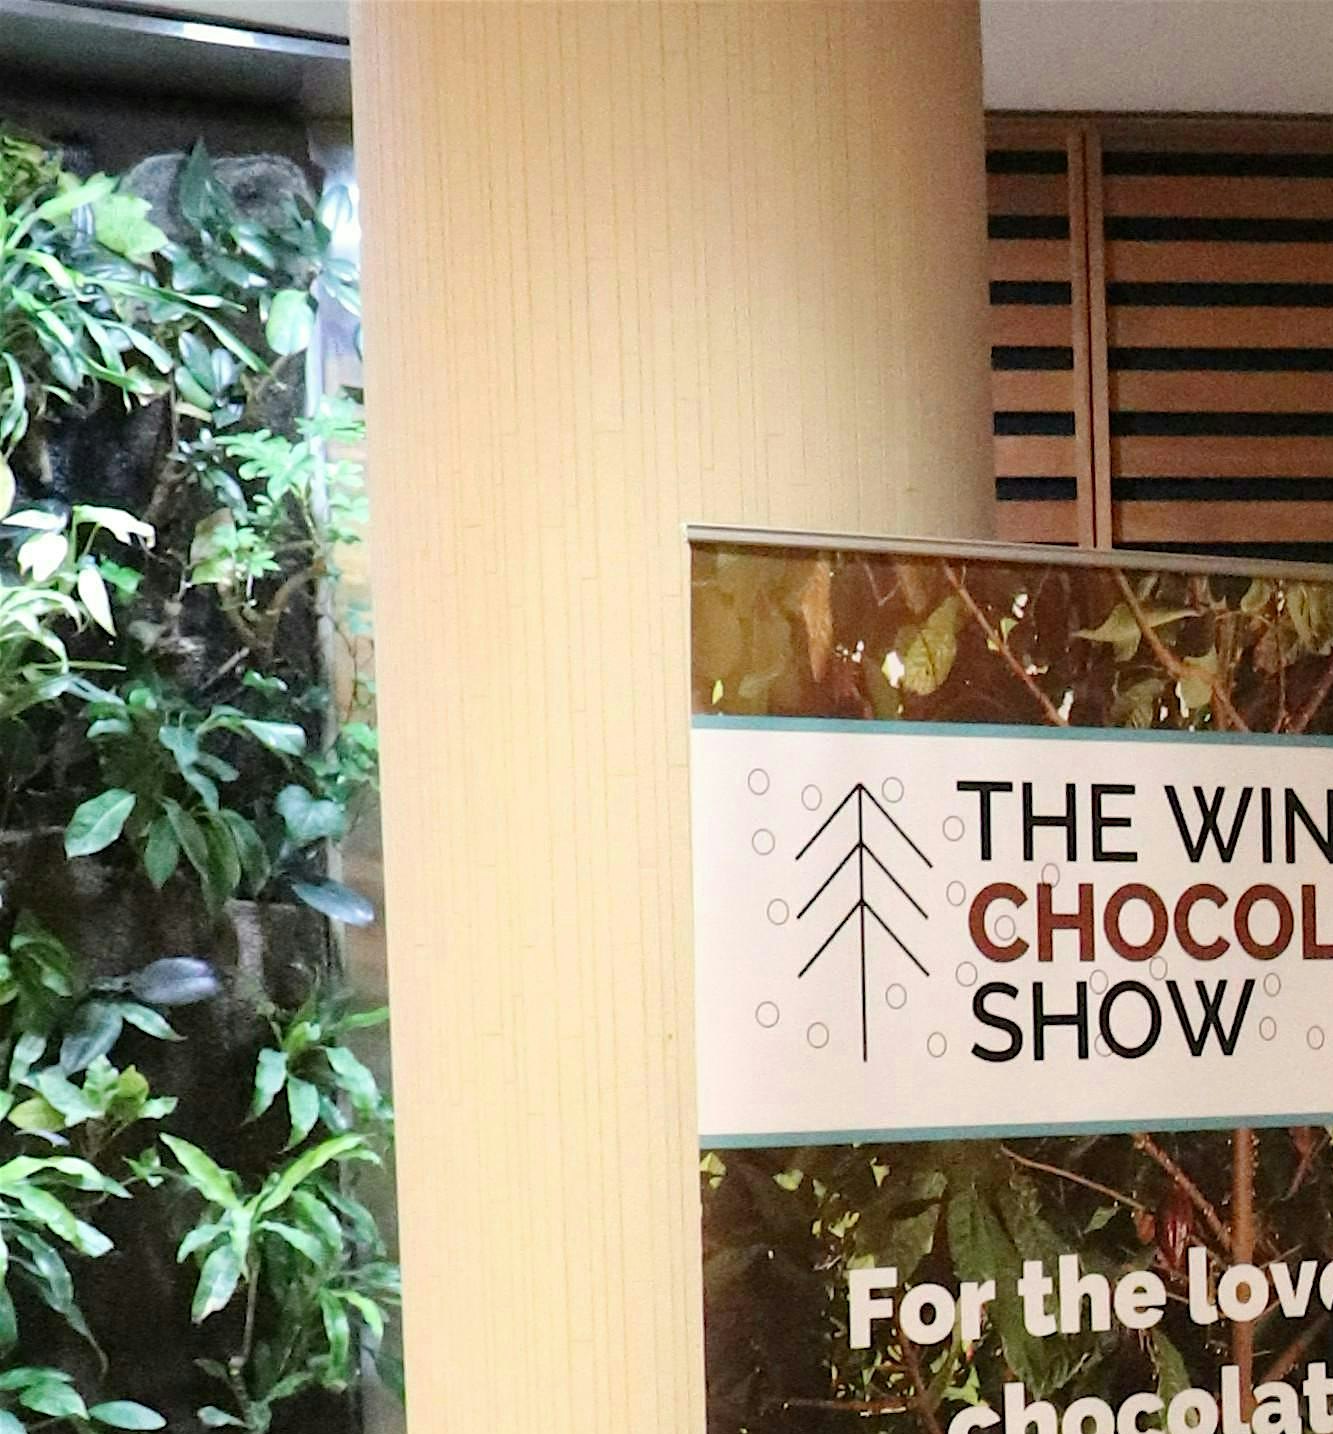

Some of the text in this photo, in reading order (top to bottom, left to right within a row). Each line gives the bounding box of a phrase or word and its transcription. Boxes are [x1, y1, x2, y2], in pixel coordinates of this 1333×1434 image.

[957, 780, 1138, 862] THE
[971, 978, 1256, 1063] SHOW
[848, 1267, 997, 1350] For
[1017, 1253, 1168, 1338] the
